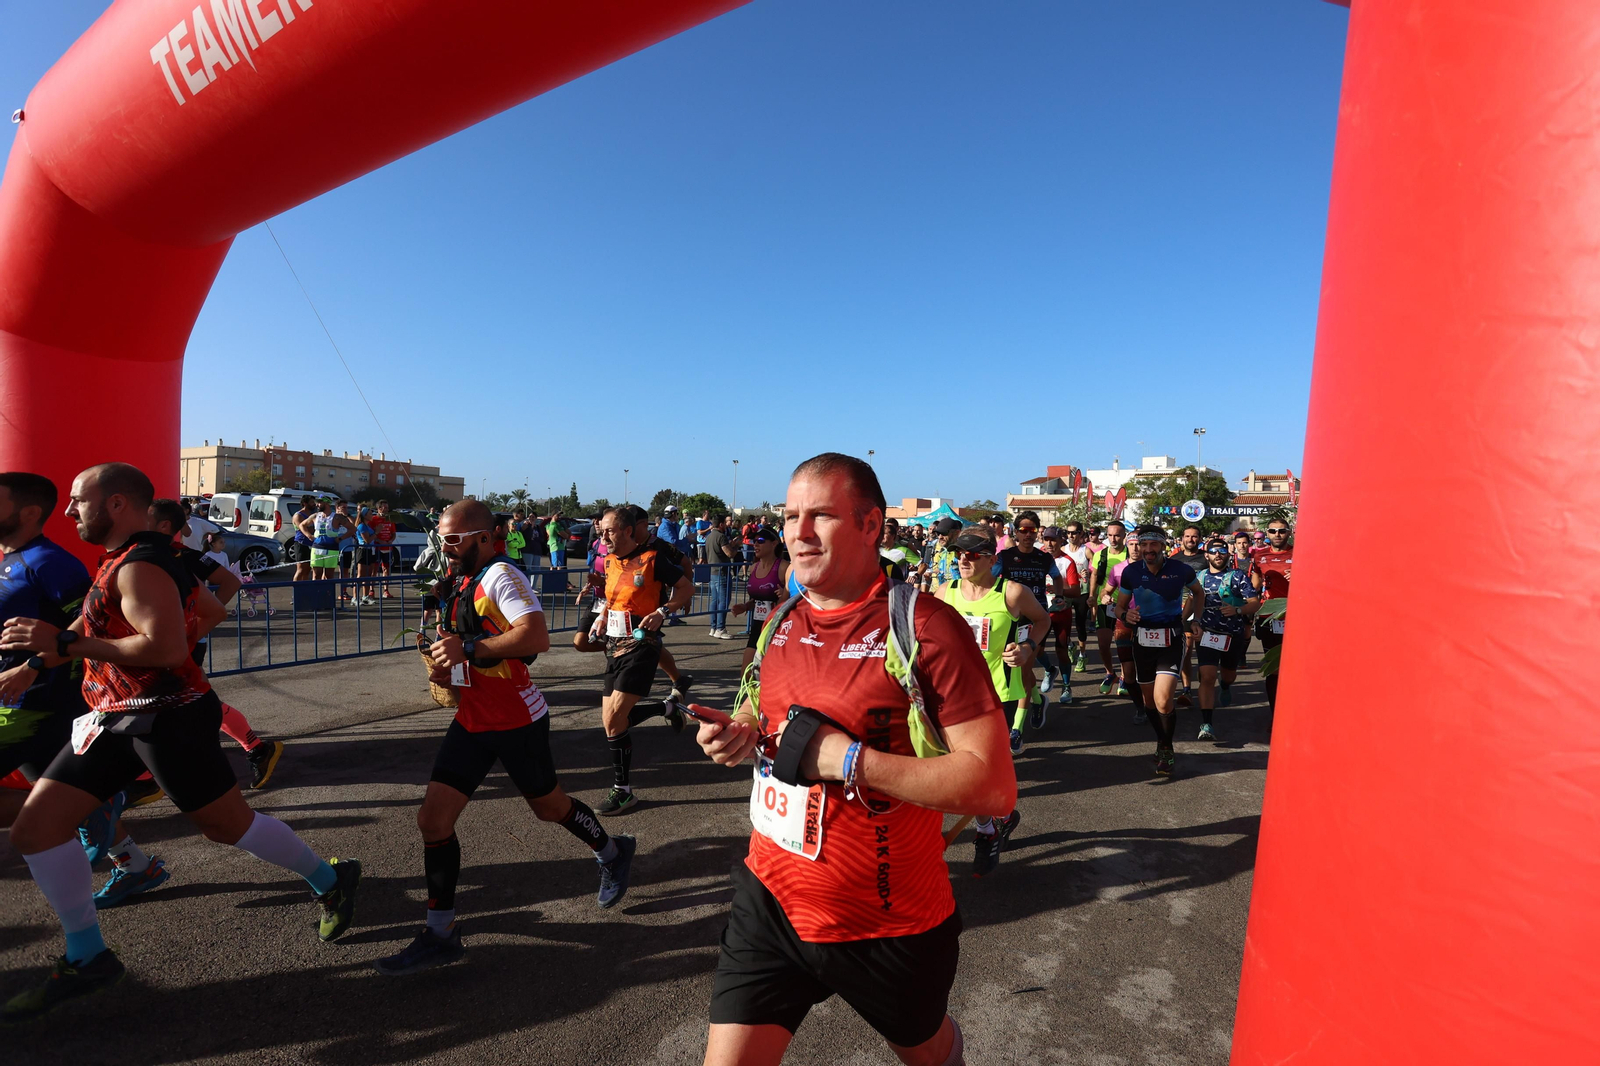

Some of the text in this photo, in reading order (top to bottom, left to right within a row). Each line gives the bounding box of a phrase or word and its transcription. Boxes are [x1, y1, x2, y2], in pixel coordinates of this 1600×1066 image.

[149, 0, 314, 107] TEAME
[1210, 507, 1236, 515] TRAIL
[756, 606, 768, 614] 390
[981, 622, 989, 646] PIRATA
[1144, 631, 1160, 640] 152
[1209, 635, 1219, 643] 20
[757, 780, 788, 818] 103
[574, 810, 601, 839] WONG
[806, 791, 821, 846] PIRATA
[875, 825, 893, 911] 24 K 600D+
